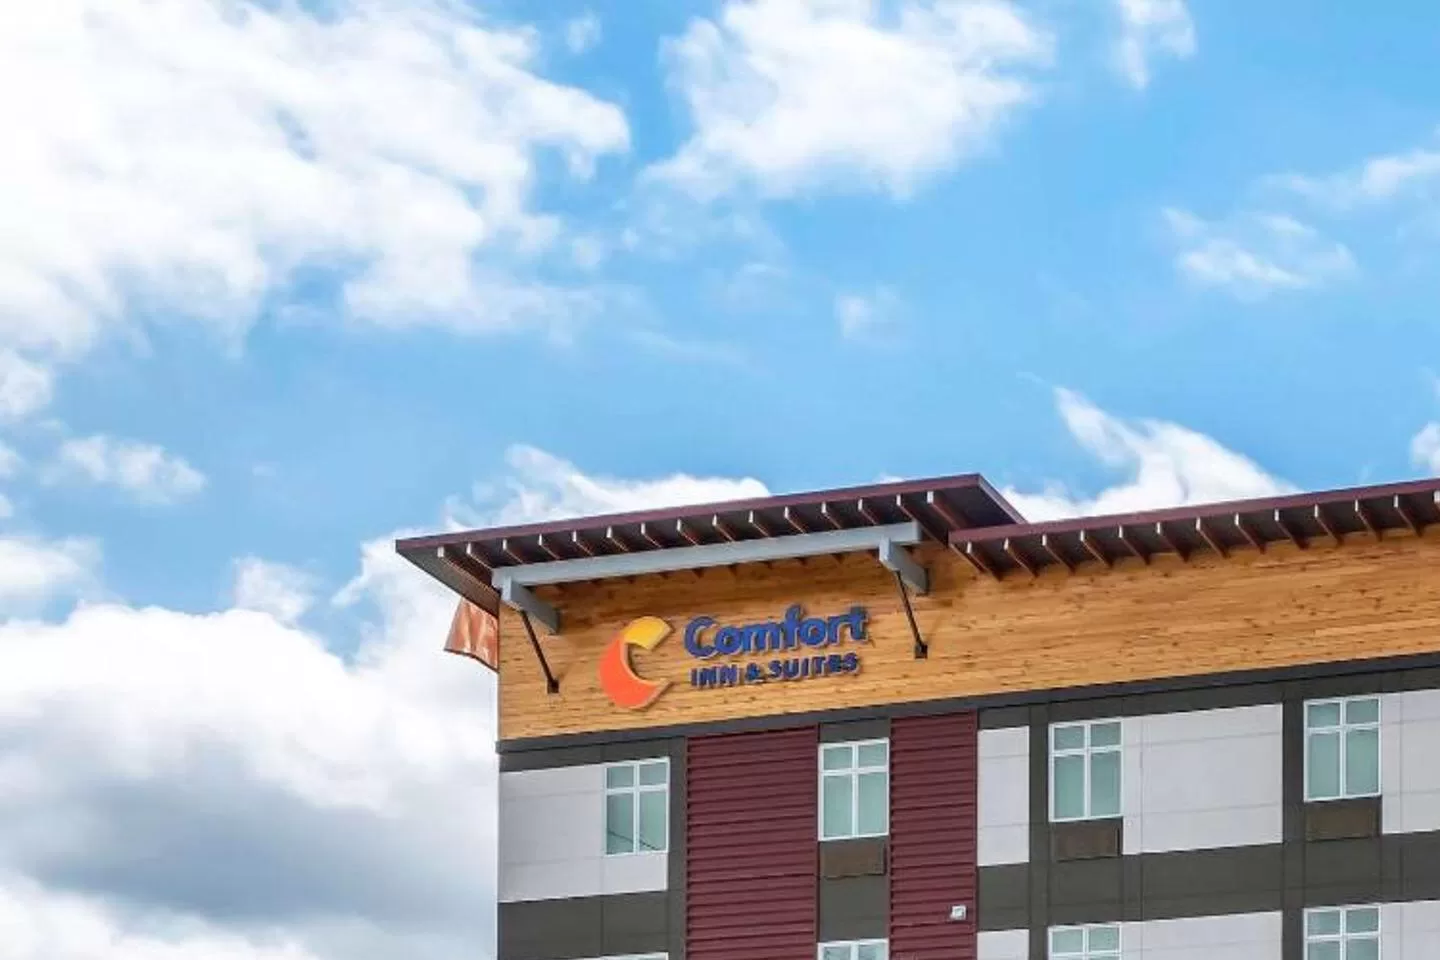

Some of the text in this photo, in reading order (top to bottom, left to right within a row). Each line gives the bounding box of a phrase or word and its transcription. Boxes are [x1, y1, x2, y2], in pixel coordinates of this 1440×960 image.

[684, 605, 868, 658] Comfort
[690, 651, 861, 688] INN & SUITES
